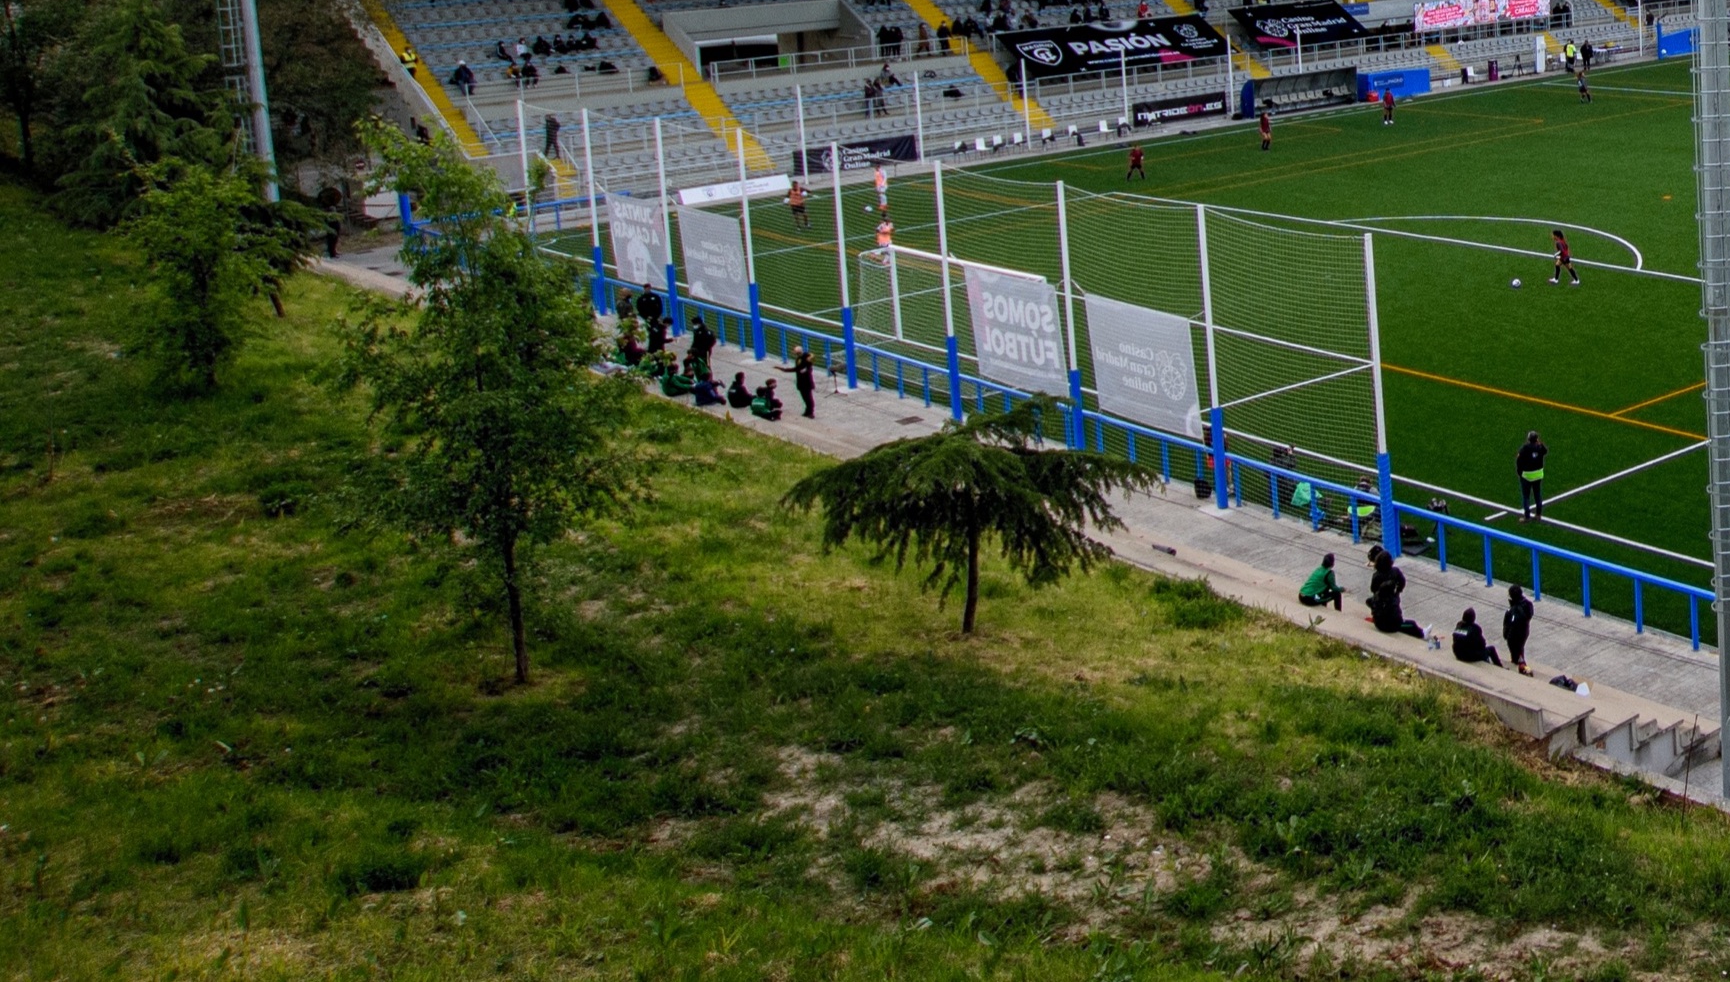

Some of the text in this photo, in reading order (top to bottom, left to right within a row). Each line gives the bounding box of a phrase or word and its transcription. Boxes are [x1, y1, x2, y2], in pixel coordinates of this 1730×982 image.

[1068, 33, 1172, 56] PASIÓN
[842, 147, 868, 155] Casino
[863, 149, 890, 158] Madrid
[844, 161, 870, 170] Online
